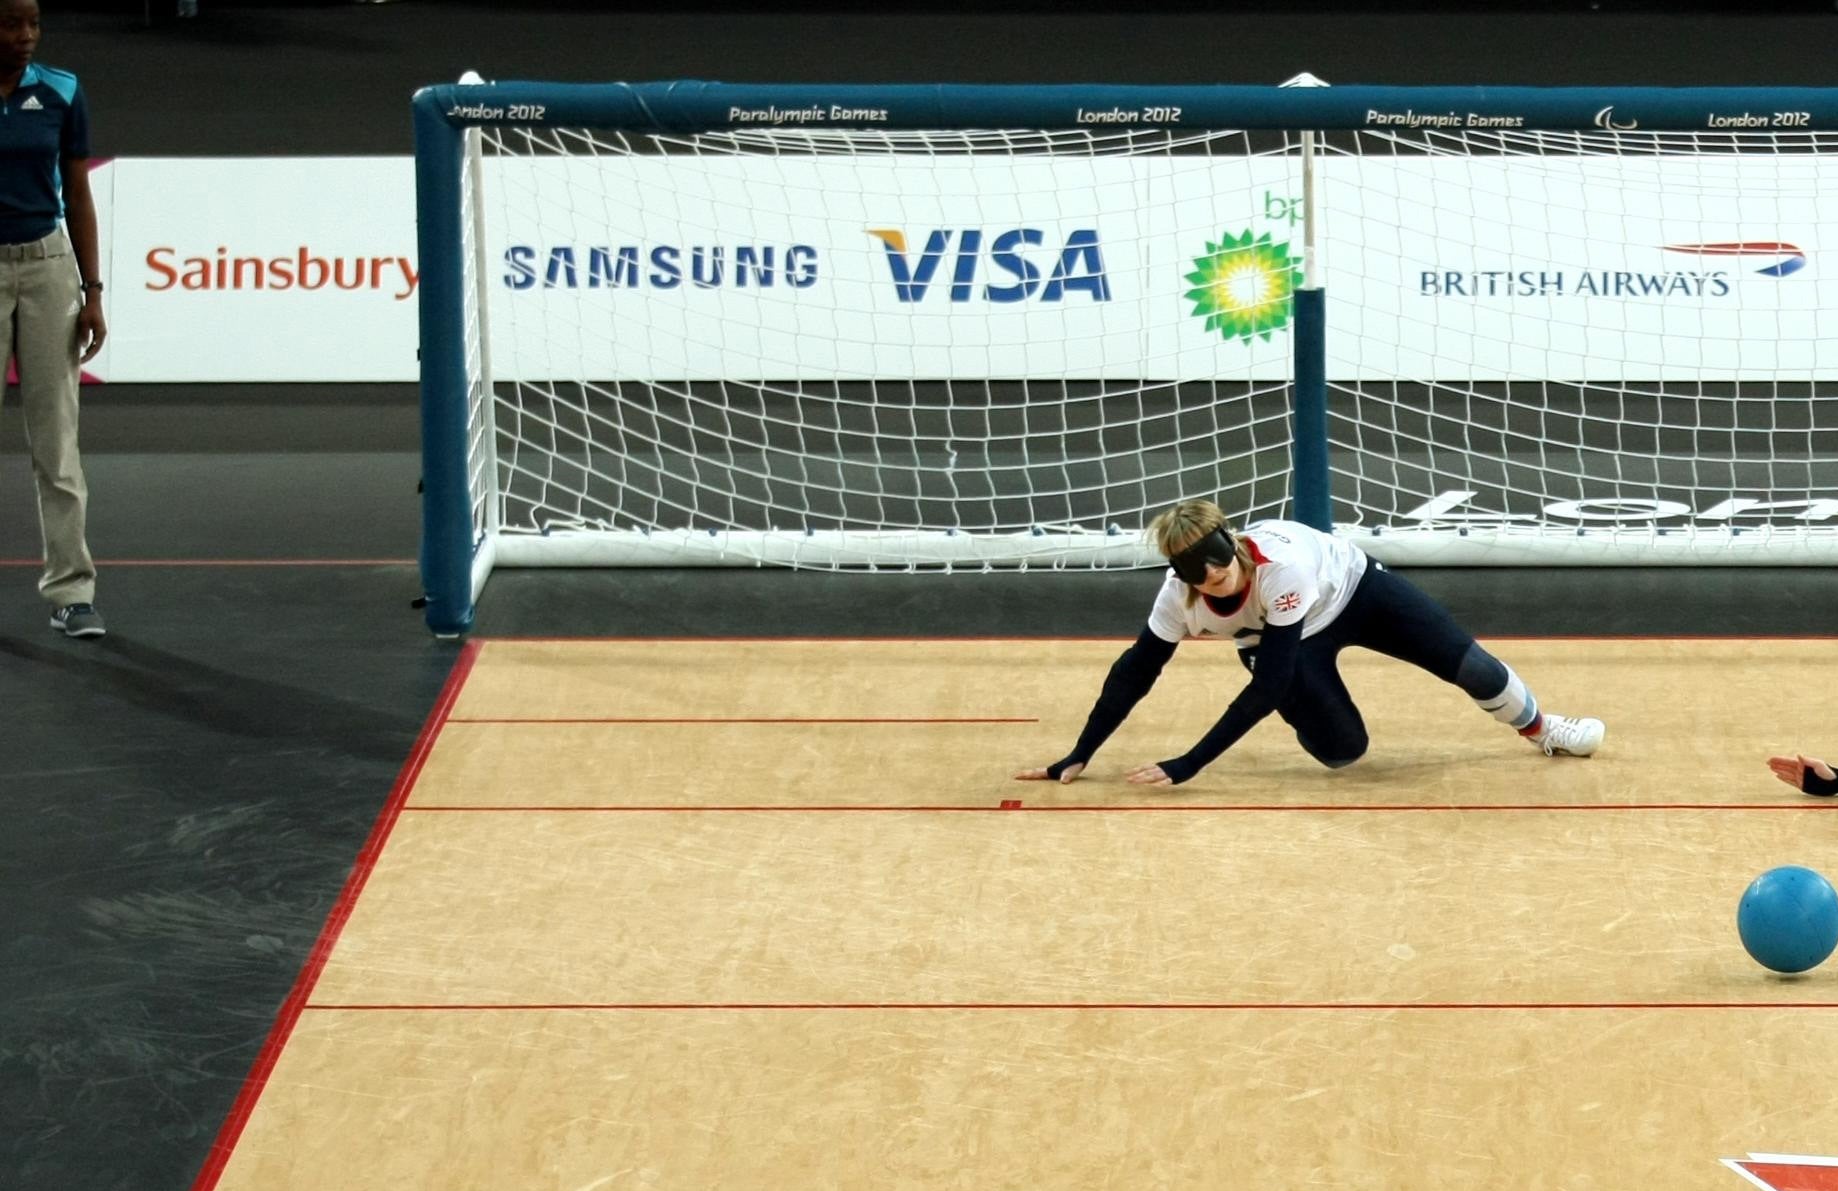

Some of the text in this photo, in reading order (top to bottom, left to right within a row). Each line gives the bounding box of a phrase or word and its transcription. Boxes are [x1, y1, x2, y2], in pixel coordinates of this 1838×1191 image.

[508, 104, 545, 120] 2012
[729, 105, 888, 123] Paralympic Games
[1077, 107, 1181, 123] London 2012
[1366, 109, 1524, 128] Paralympic Games
[1708, 111, 1810, 128] London 2012
[145, 246, 420, 300] Sainsbury
[503, 245, 820, 290] SAMSUNG
[863, 228, 1112, 302] VISA
[1420, 271, 1730, 296] BRITISH AIRWAYS
